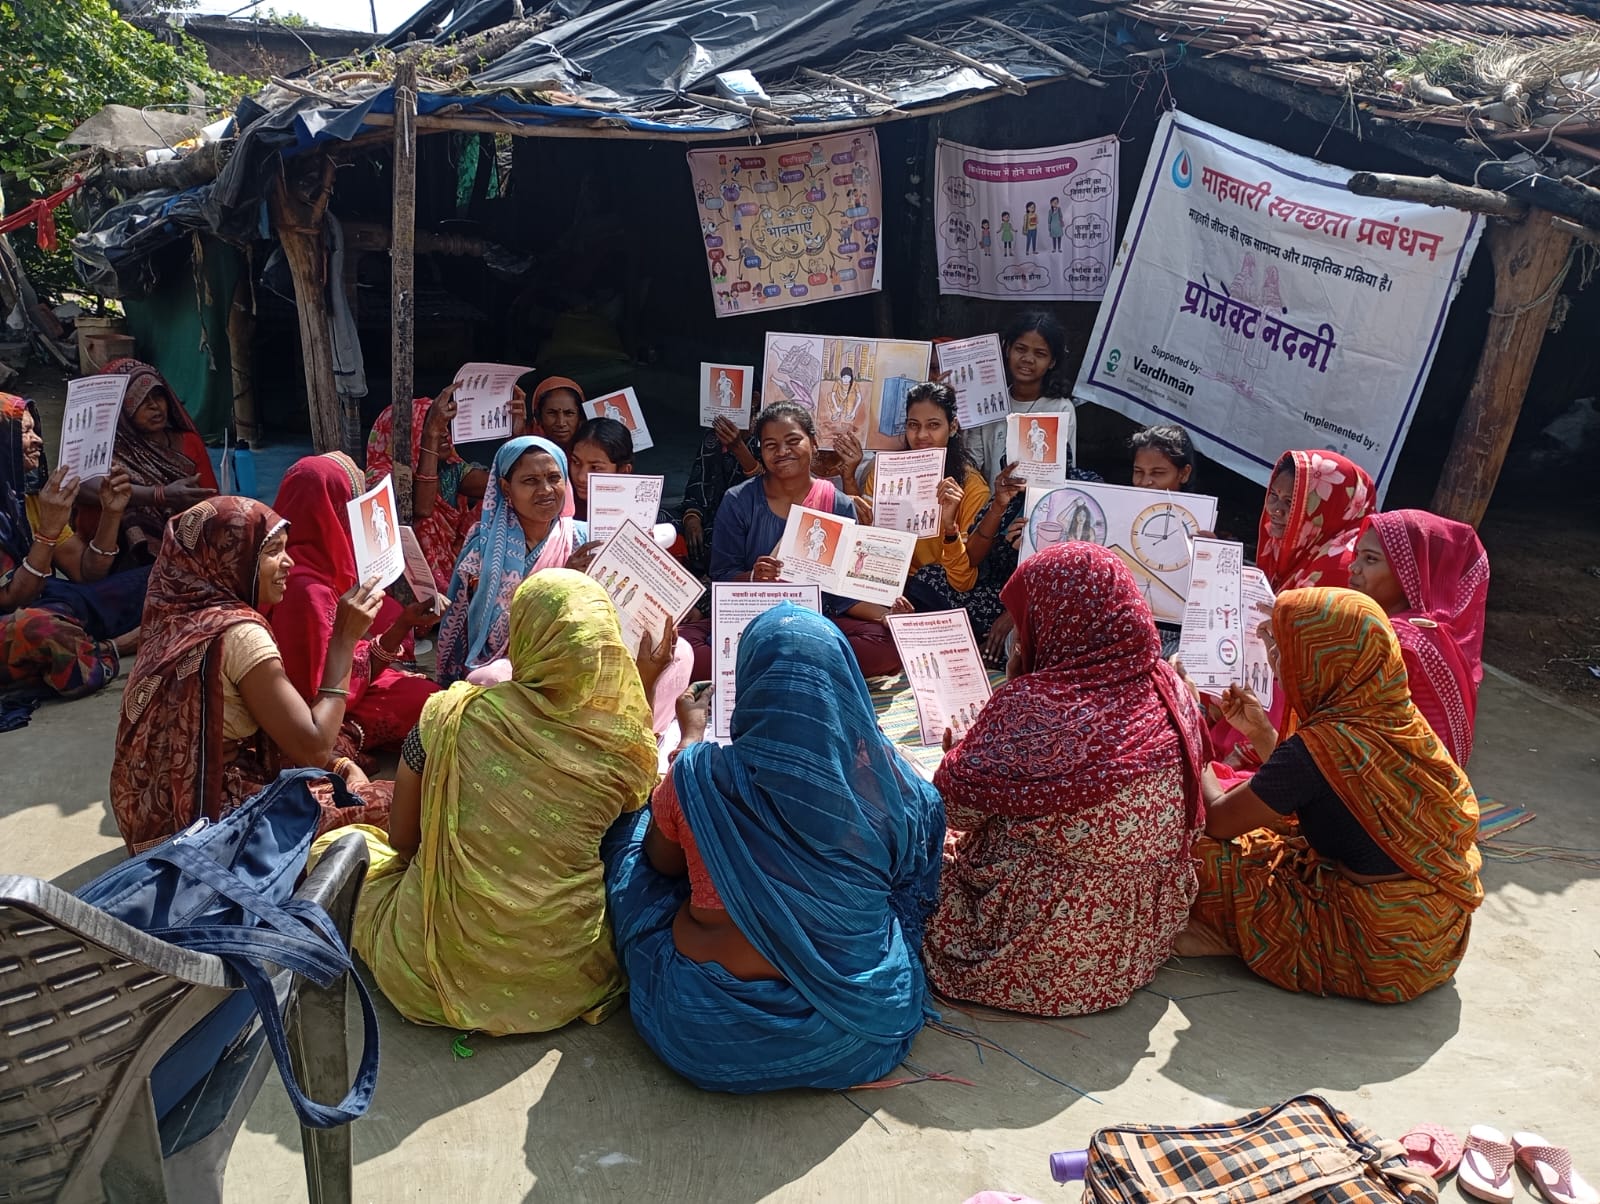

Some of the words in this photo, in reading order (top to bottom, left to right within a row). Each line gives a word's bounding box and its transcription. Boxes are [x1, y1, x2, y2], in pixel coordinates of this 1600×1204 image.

[1201, 167, 1271, 212] माहवारी
[1268, 195, 1357, 239] स्वच्छता
[1355, 216, 1444, 262] प्रबंधन
[1210, 216, 1229, 238] जीवन
[1229, 224, 1240, 242] की
[1240, 232, 1254, 247] एक
[1253, 238, 1281, 258] सामान्य
[1282, 246, 1300, 264] और
[1300, 253, 1343, 276] प्राकृतिक
[1343, 265, 1379, 288] प्रक्रिया
[1180, 272, 1261, 339] प्रोजेक्ट
[1262, 306, 1336, 373] नंदनी
[1133, 356, 1195, 396] Vardhman
[1151, 344, 1189, 369] Supported
[1303, 411, 1363, 443] Implemented
